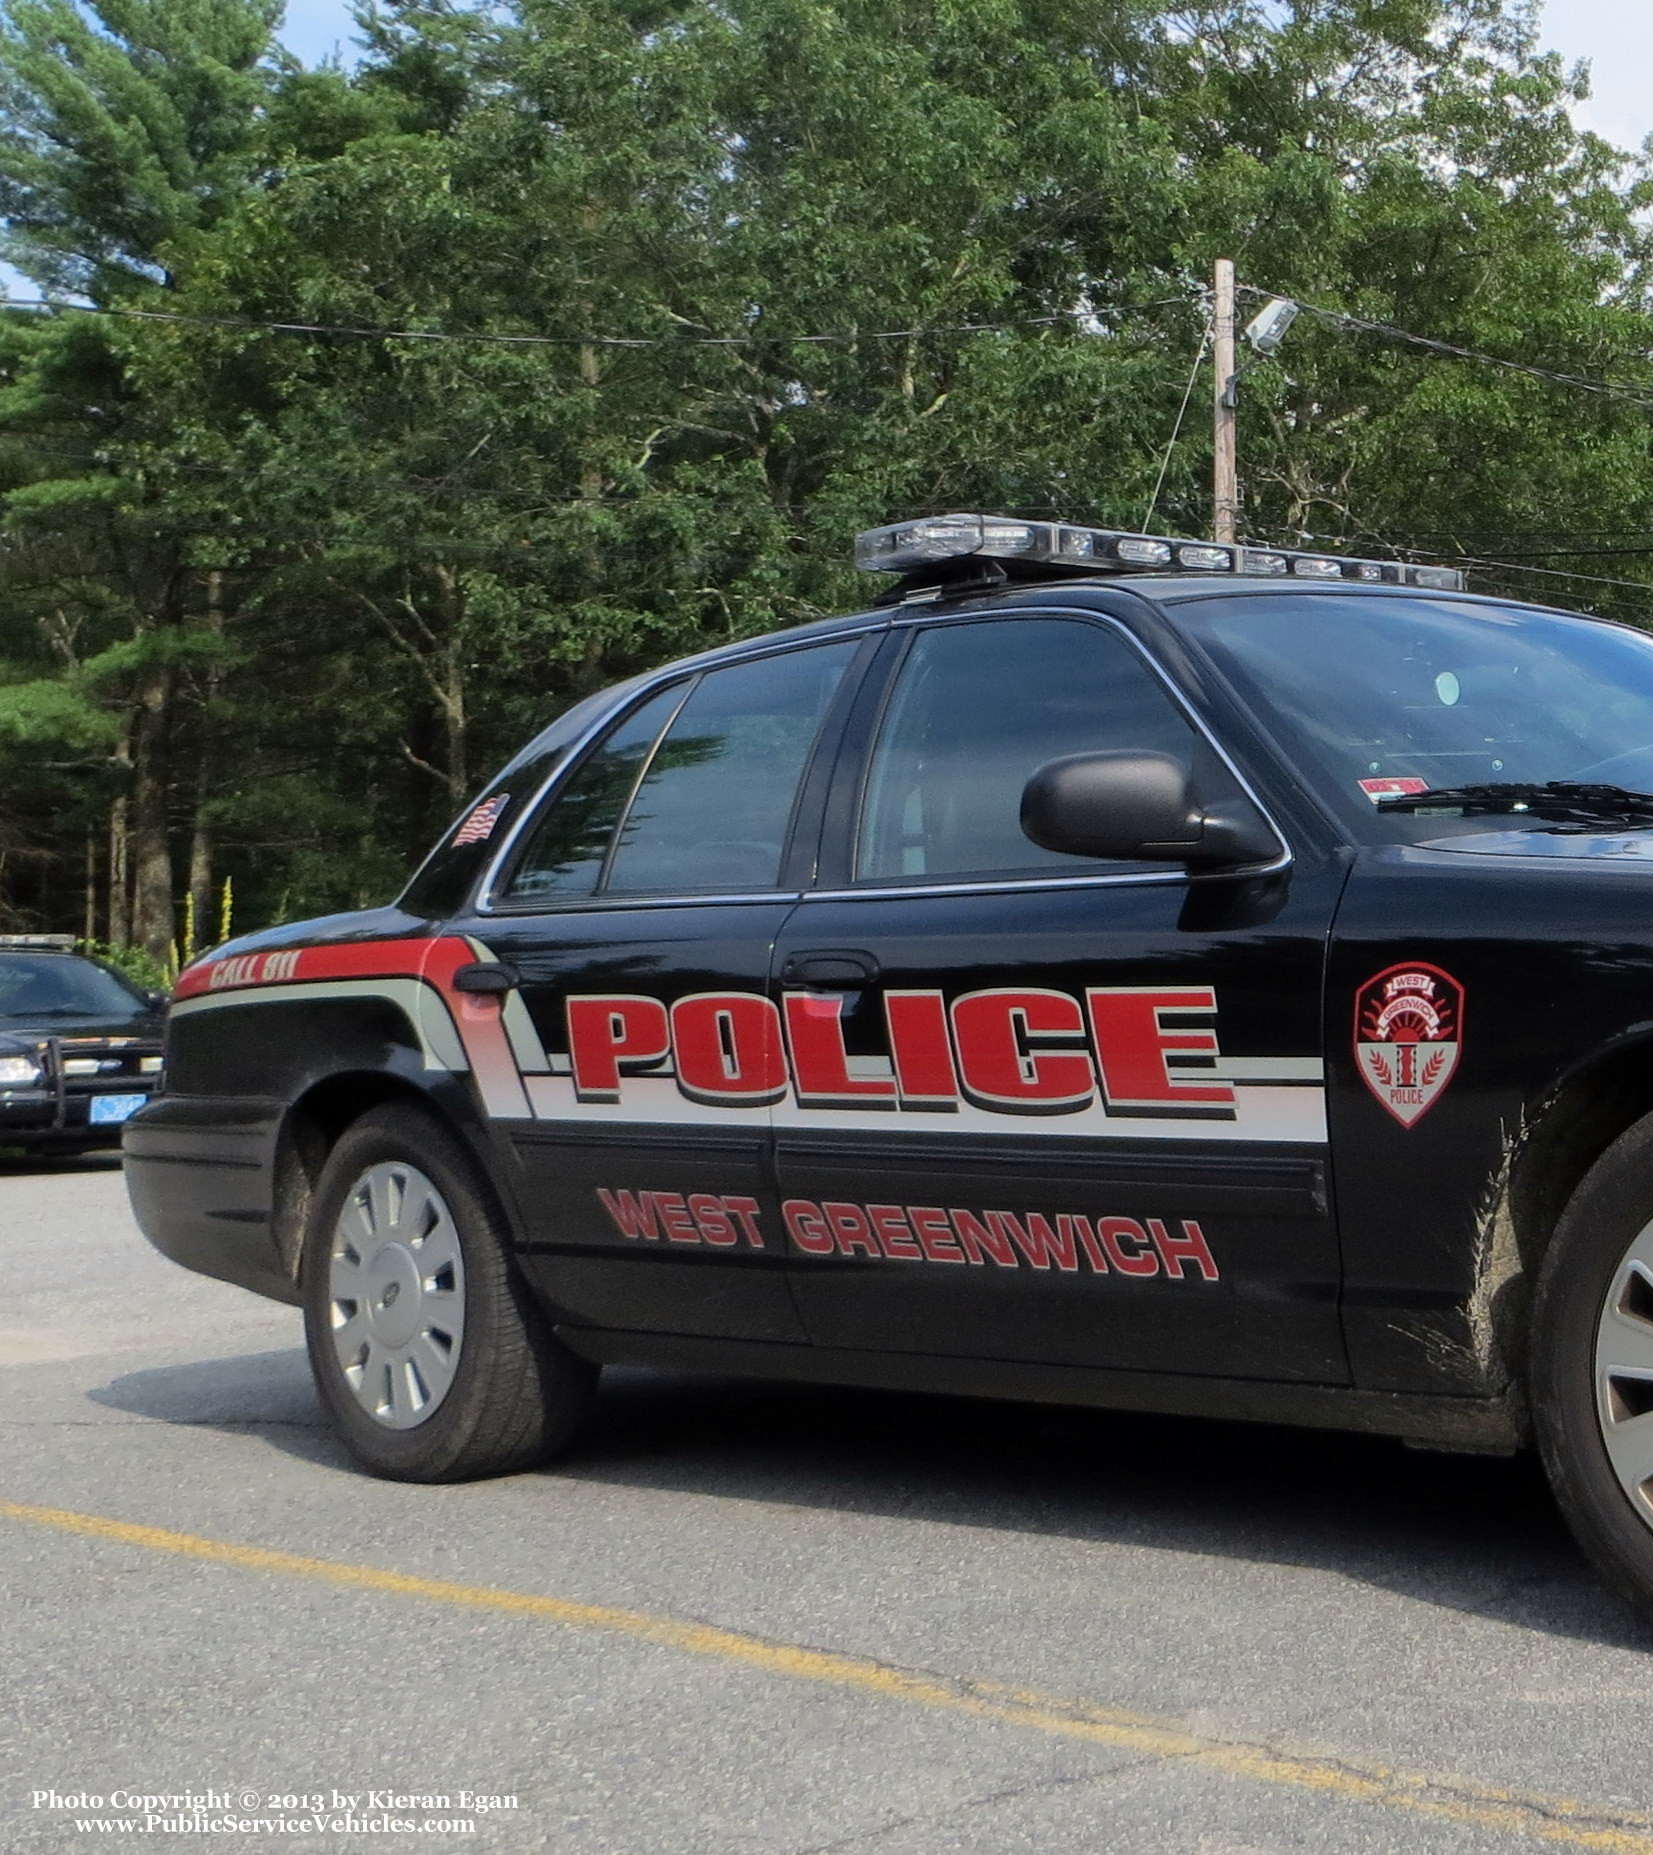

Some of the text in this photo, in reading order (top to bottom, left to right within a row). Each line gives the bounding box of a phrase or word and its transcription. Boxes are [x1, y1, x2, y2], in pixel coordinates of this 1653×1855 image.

[209, 949, 303, 988] CALL 911
[1396, 975, 1426, 987] WEST
[1383, 998, 1435, 1021] GREENWICH
[565, 985, 1238, 1121] POLICE
[1389, 1088, 1425, 1105] POLICE
[597, 1188, 1220, 1281] WEST GREENWICH
